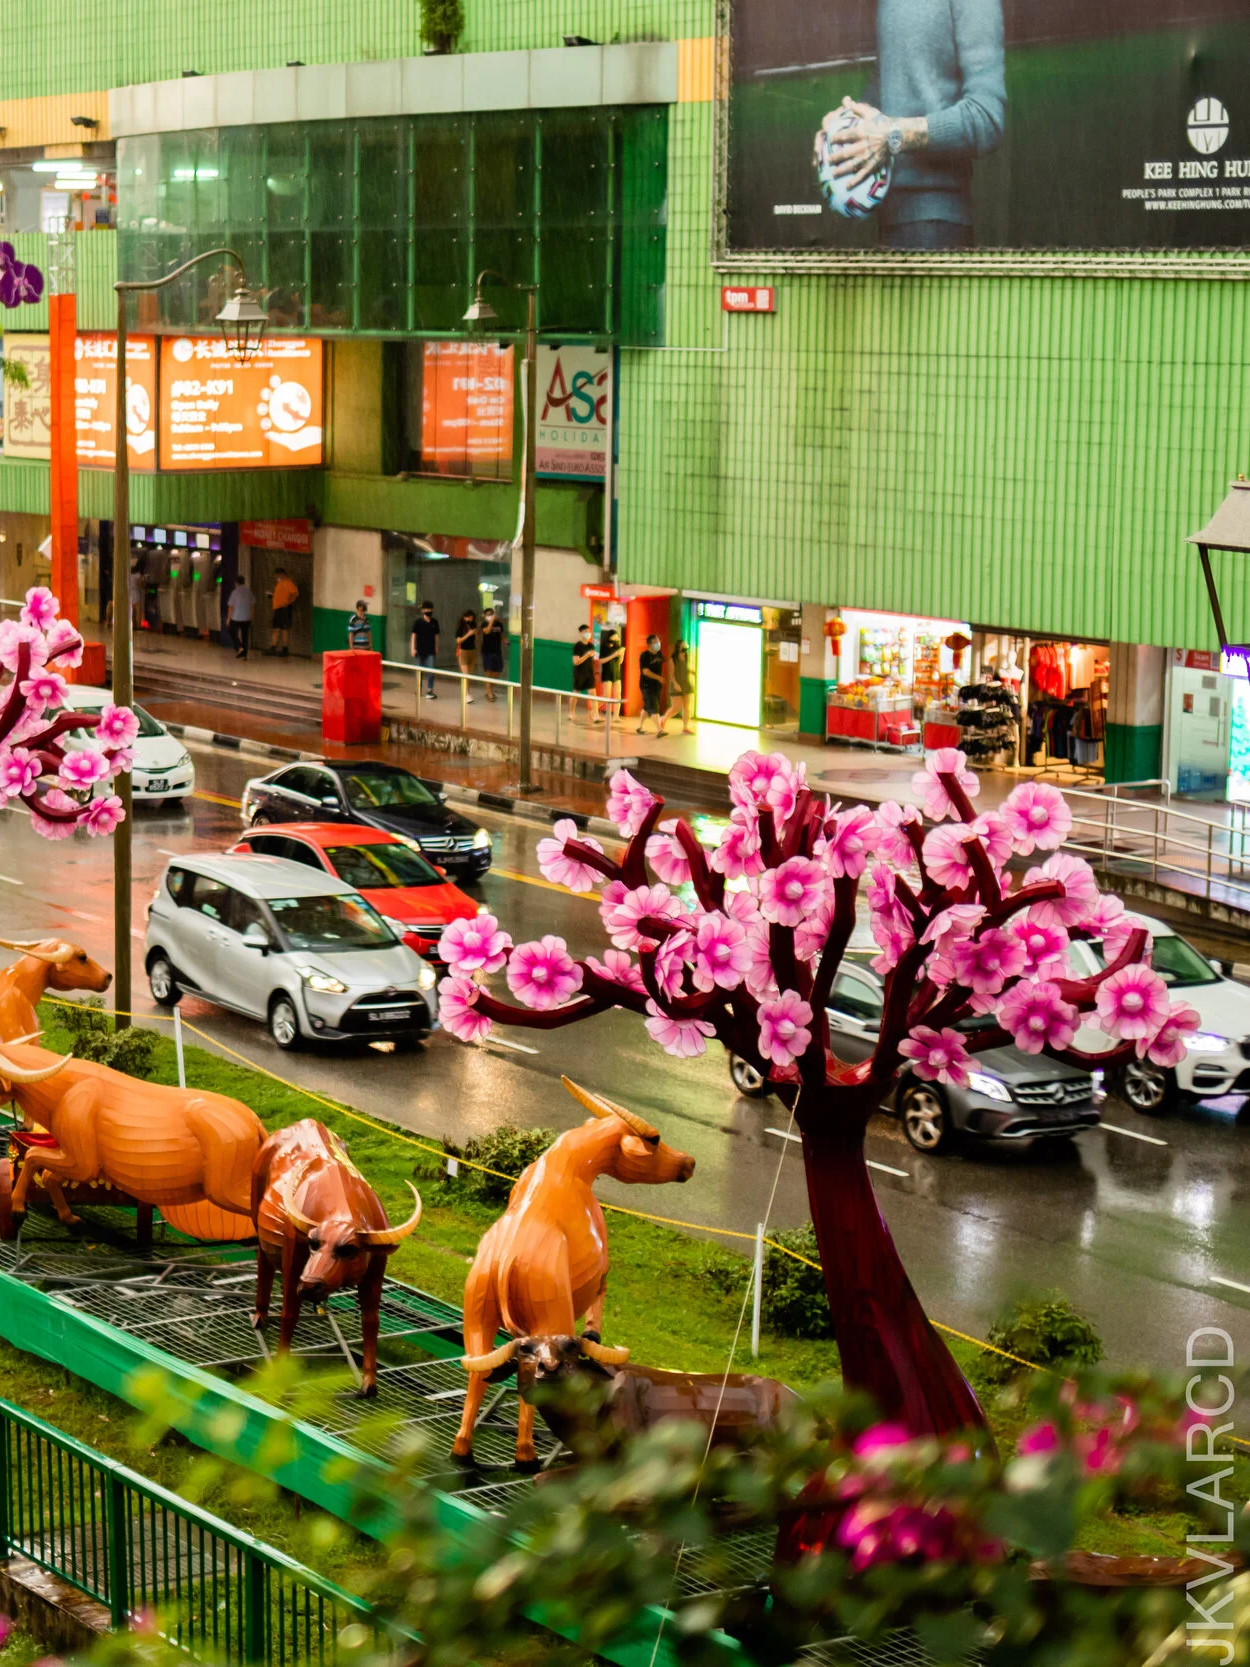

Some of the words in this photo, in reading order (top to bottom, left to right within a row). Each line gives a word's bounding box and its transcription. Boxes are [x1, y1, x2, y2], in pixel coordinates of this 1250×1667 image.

[1144, 162, 1172, 179] KEE
[1178, 161, 1218, 178] HING
[1122, 188, 1156, 199] PEOPLE'S
[1157, 188, 1177, 198] PARK
[1178, 187, 1213, 198] COMPLEX
[1221, 186, 1241, 197] PARK
[540, 430, 607, 443] HOLIDA
